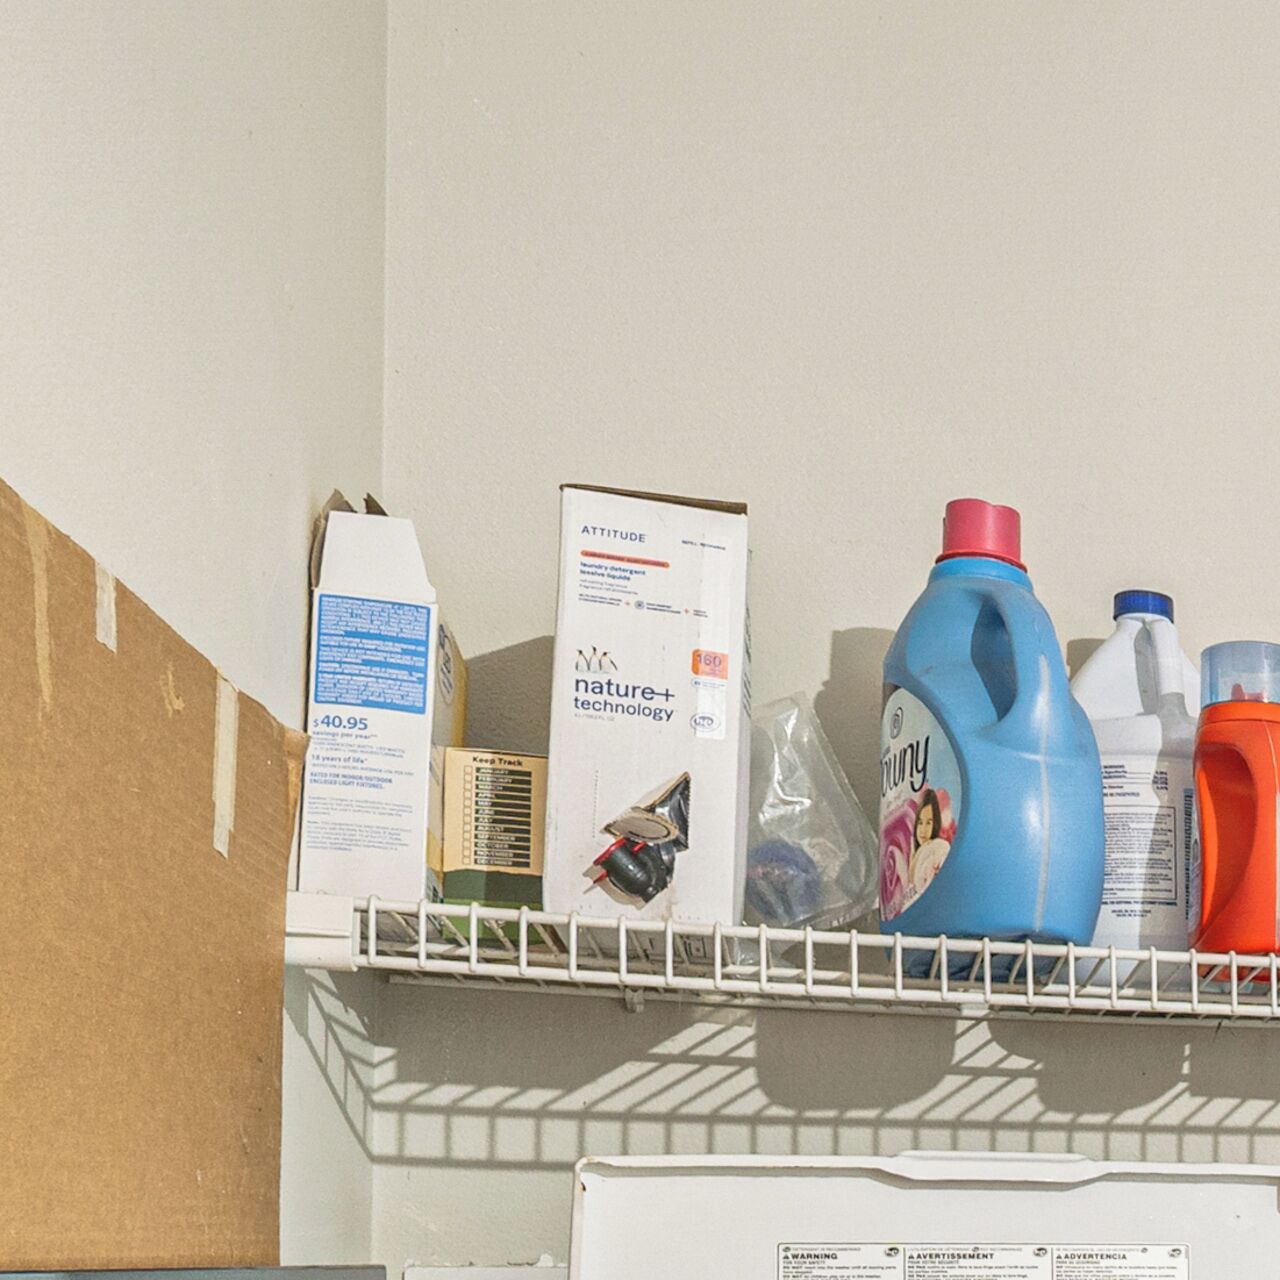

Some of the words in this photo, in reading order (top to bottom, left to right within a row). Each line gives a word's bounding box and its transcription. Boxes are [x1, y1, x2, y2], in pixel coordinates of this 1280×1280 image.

[581, 525, 646, 543] ATTITUDE
[697, 654, 721, 667] 160
[574, 696, 674, 722] technology
[313, 714, 368, 731] $40.95
[472, 756, 496, 765] Keep
[498, 758, 522, 766] Track
